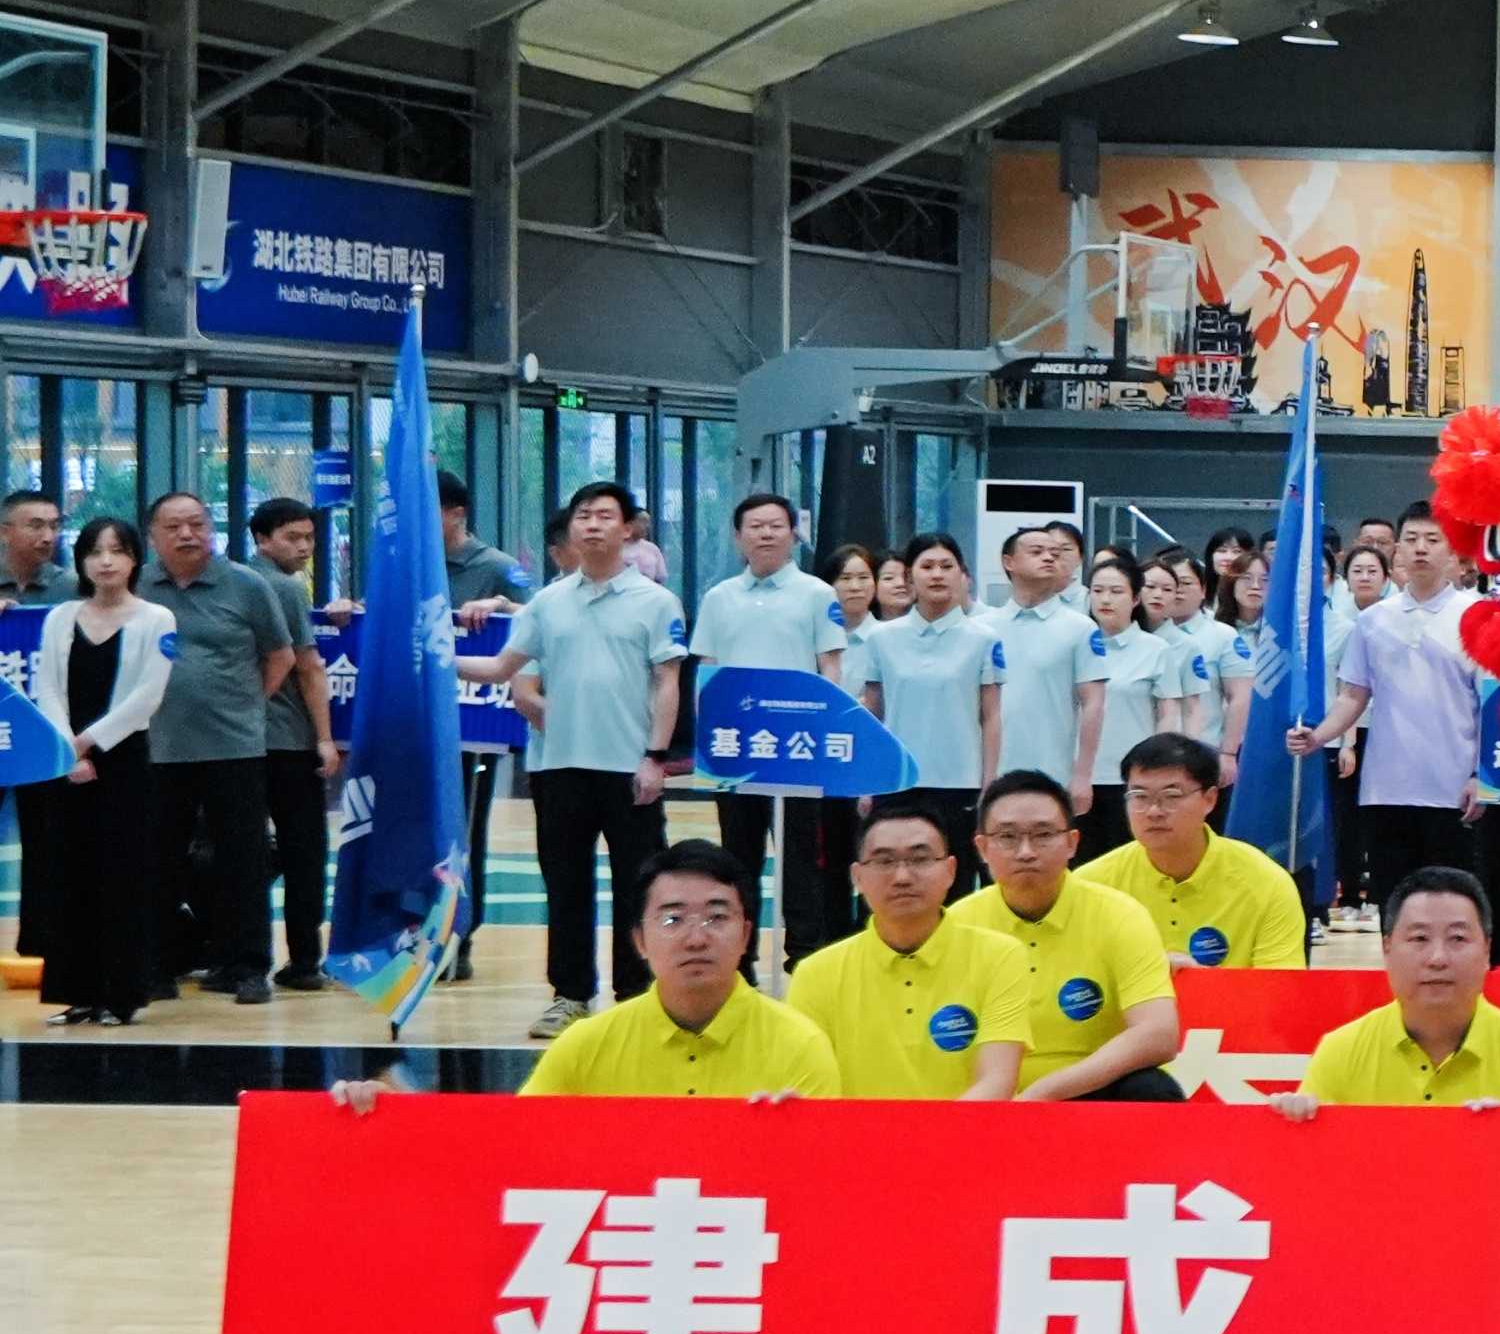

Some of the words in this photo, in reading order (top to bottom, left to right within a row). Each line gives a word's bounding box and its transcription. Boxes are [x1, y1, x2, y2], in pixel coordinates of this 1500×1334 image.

[252, 228, 446, 289] 湖北铁路集团有限公司
[278, 282, 308, 303] Hubei
[310, 286, 348, 310] Railway
[350, 290, 380, 314] Group
[862, 444, 876, 465] A2
[710, 726, 854, 763] 基金公司
